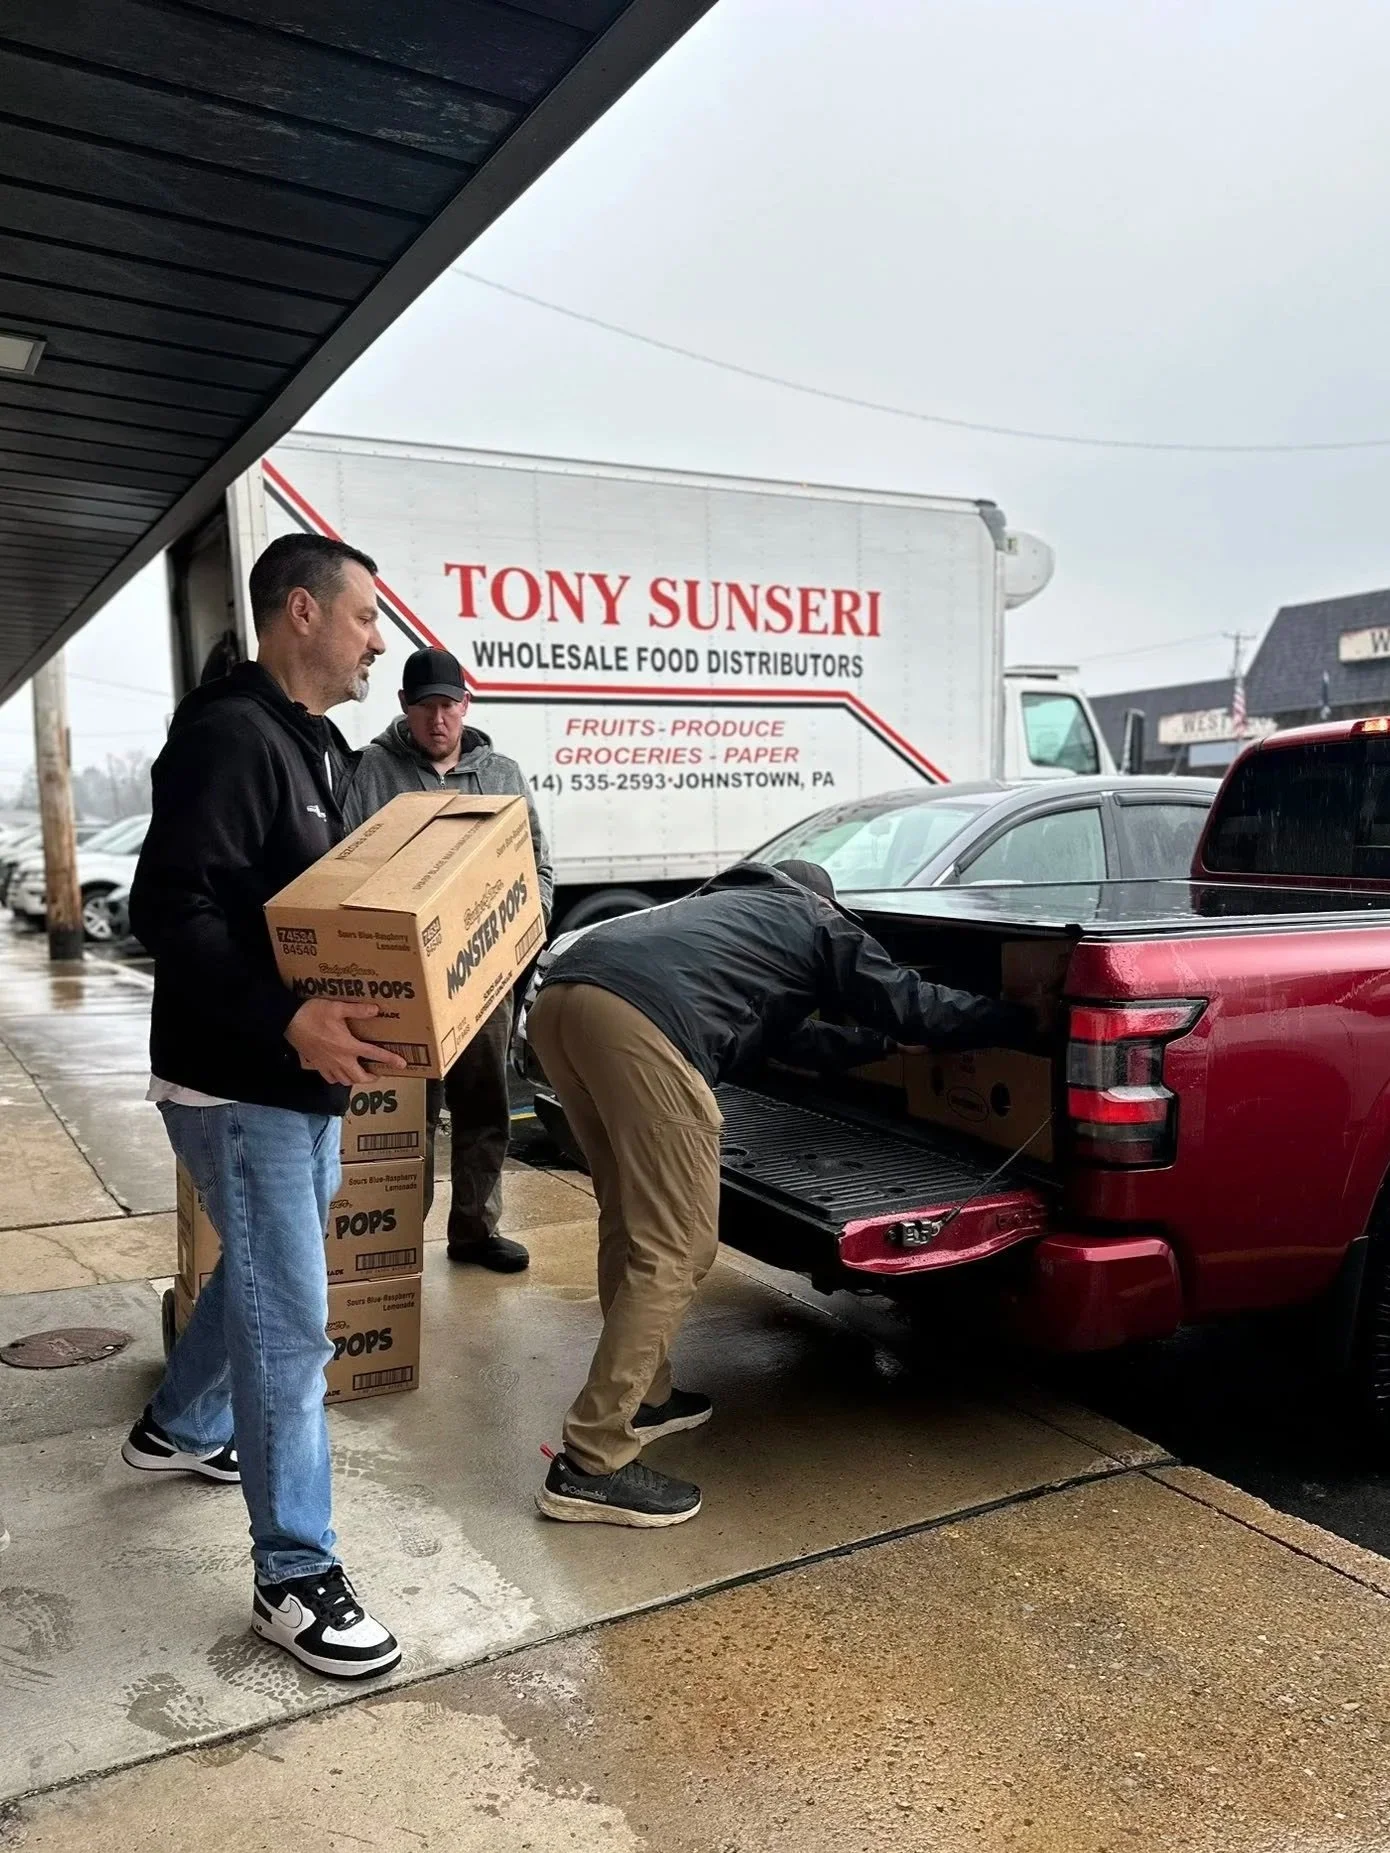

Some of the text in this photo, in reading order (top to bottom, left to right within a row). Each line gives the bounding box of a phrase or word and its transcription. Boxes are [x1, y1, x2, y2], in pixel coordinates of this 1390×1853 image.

[444, 563, 881, 637] TONY SUNSERI
[472, 640, 864, 678] WHOLESALE FOOD DISTRIBUTORS
[565, 718, 656, 737] FRUITS
[670, 719, 785, 737] PRODUCE
[555, 747, 703, 765] GROCERIES
[723, 746, 800, 764] PAPER
[528, 774, 563, 796] 14)
[811, 770, 835, 788] PA
[446, 909, 500, 1000] MONSTER
[498, 872, 528, 935] POPS
[283, 943, 317, 956] 84540
[292, 976, 415, 999] MONSTER POPS
[351, 1090, 398, 1116] OPS
[385, 1183, 417, 1192] Lemonade
[335, 1208, 397, 1240] POPS
[383, 1301, 415, 1311] Lemonade
[332, 1327, 393, 1360] POPS
